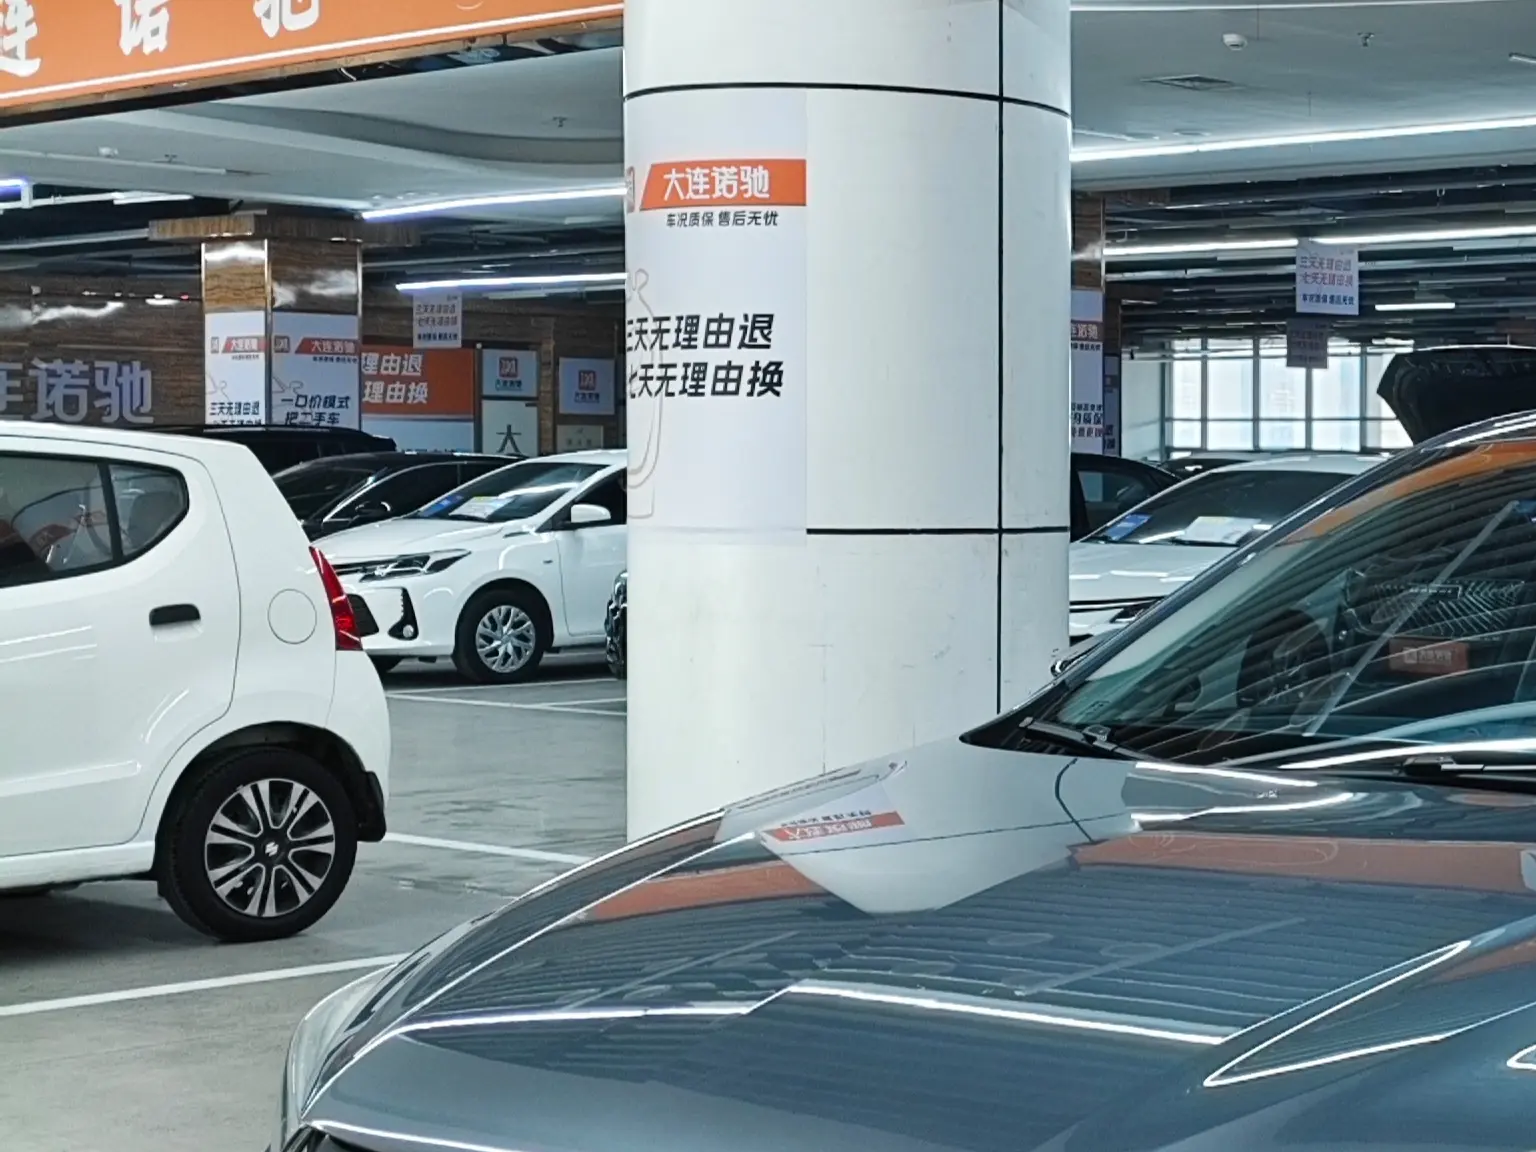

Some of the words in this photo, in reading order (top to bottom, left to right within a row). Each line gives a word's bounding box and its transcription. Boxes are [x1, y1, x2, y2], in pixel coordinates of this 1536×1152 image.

[663, 165, 771, 201] 大连诺驰
[666, 213, 715, 228] 车况质保
[718, 210, 779, 227] 售后无忧
